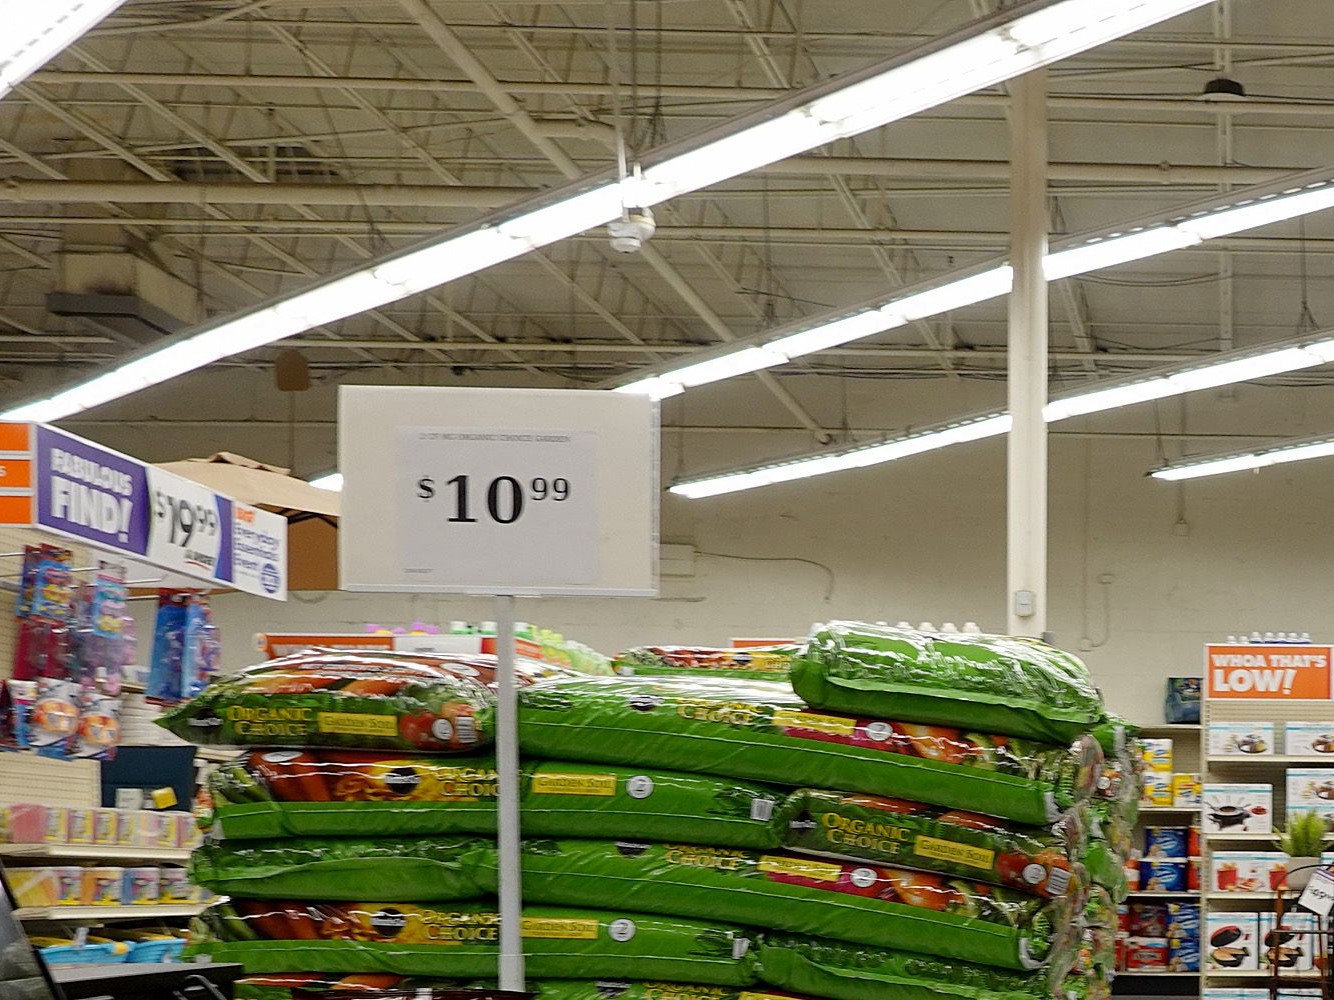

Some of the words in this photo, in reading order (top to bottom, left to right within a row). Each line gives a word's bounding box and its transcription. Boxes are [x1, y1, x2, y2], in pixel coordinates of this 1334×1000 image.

[51, 448, 133, 496] FABULOUS
[51, 475, 133, 543] FIND!
[1211, 654, 1267, 668] WHOA
[1268, 654, 1327, 668] THAT'S
[1213, 669, 1298, 695] LOW!
[226, 705, 312, 722] ORGANIC
[234, 721, 308, 736] CHOICE
[822, 812, 911, 843] ORGANIC
[827, 829, 900, 855] CHOICE
